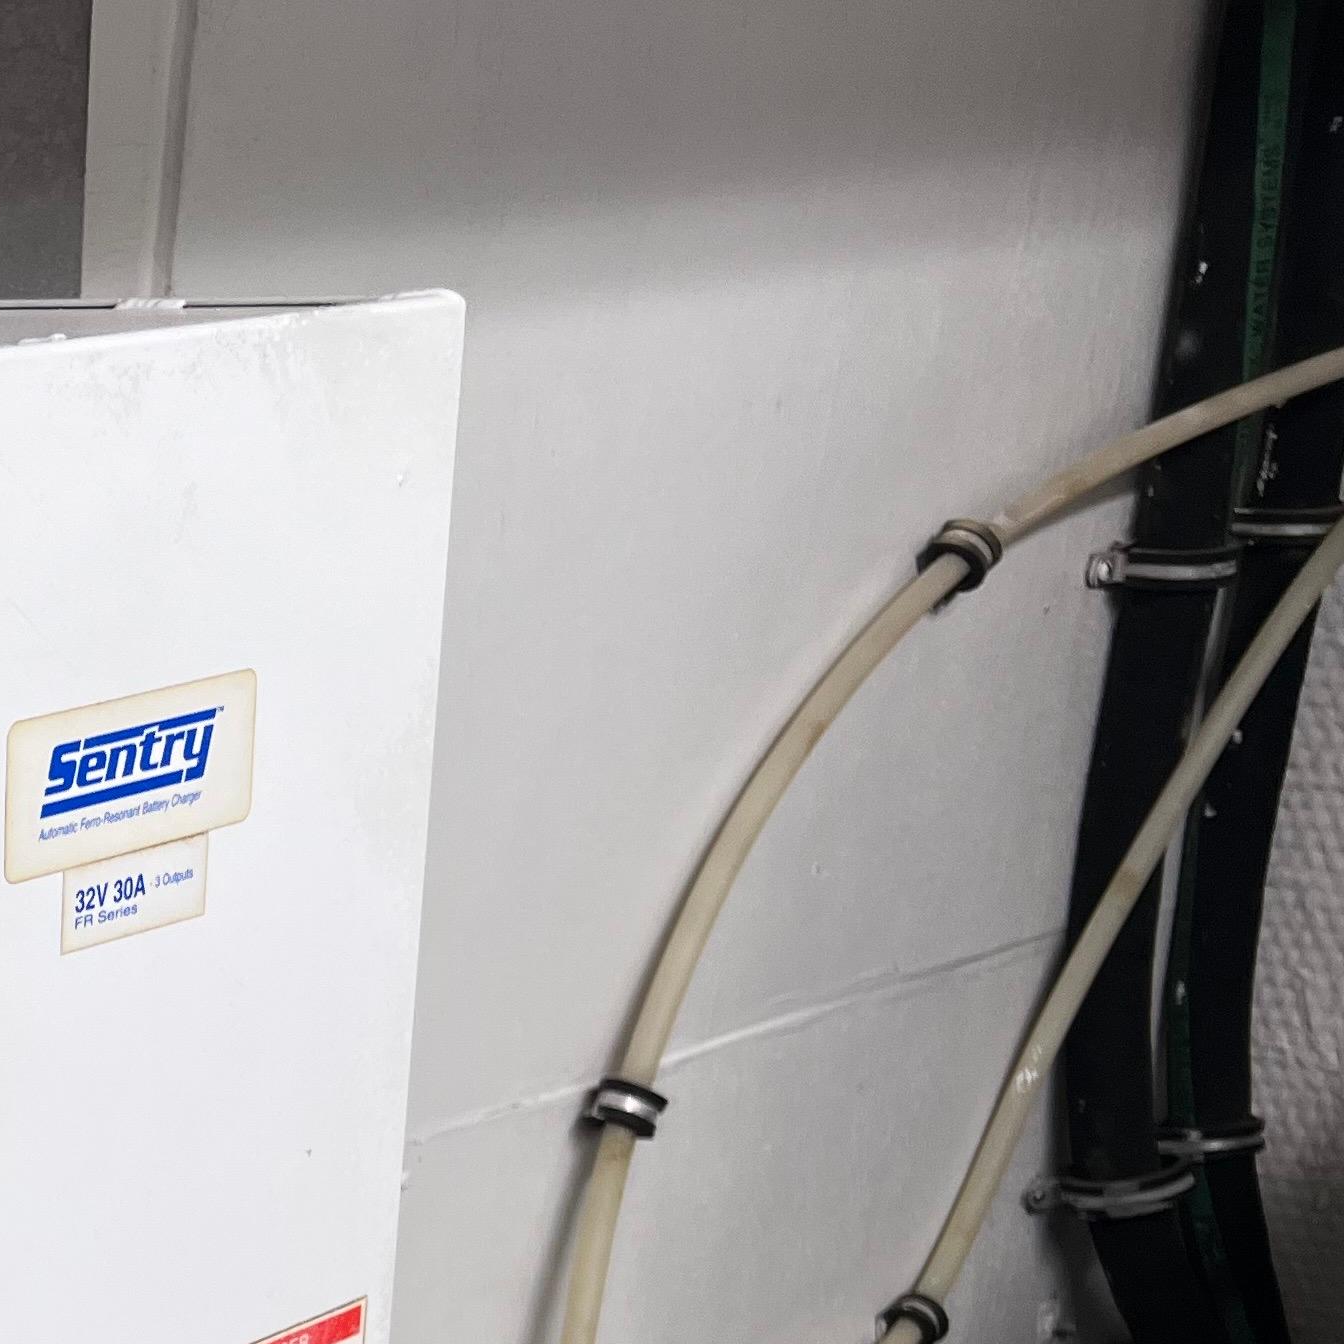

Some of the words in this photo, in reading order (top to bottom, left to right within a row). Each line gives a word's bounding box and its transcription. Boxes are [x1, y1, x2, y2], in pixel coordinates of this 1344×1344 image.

[42, 708, 218, 800] Sentry
[38, 822, 78, 842] Automatic
[80, 806, 141, 830] Ferro-Resonant
[142, 799, 171, 815] Battery
[172, 790, 202, 807] Charger
[74, 881, 109, 914] 32V
[113, 872, 146, 904] 30A
[162, 868, 194, 887] Outputs
[74, 913, 94, 930] FR
[97, 903, 139, 924] Series
